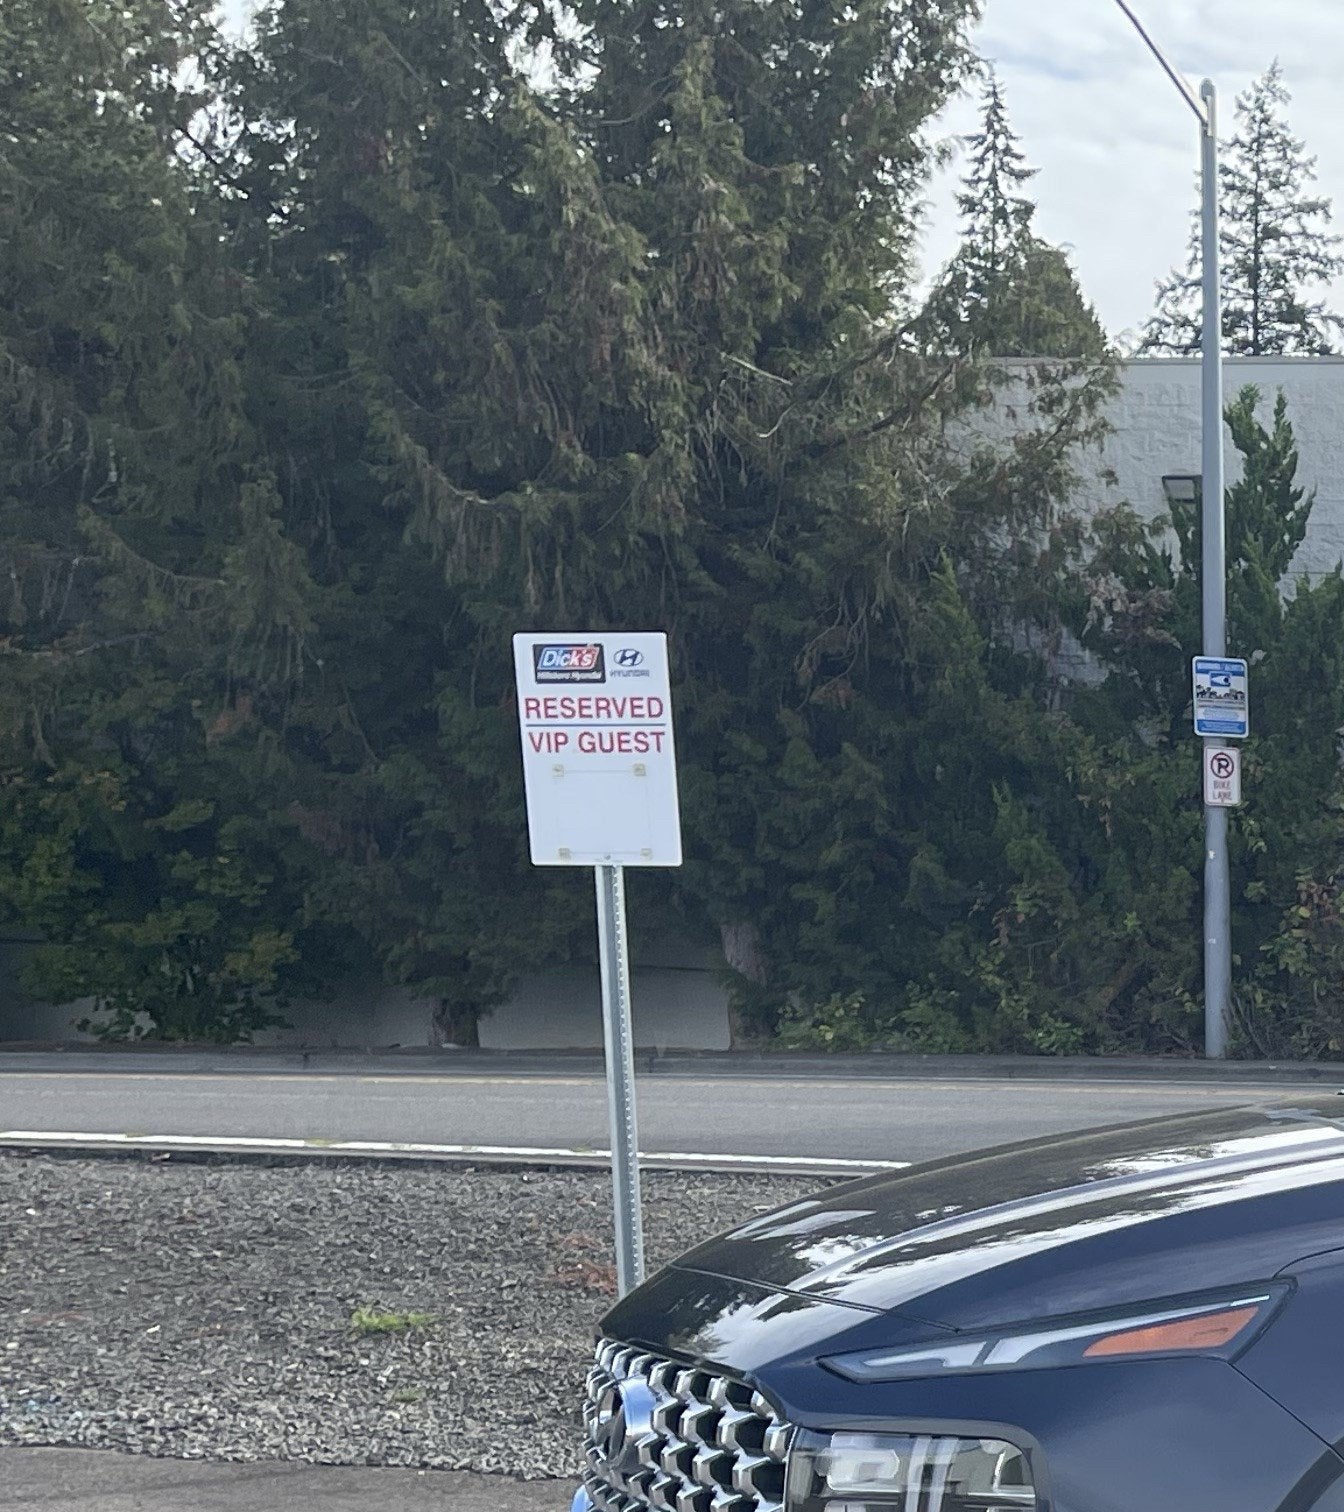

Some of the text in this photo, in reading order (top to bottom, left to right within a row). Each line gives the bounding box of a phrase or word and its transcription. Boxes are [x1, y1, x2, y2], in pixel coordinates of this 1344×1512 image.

[524, 697, 664, 719] RESERVED
[528, 731, 666, 753] VIP GUEST
